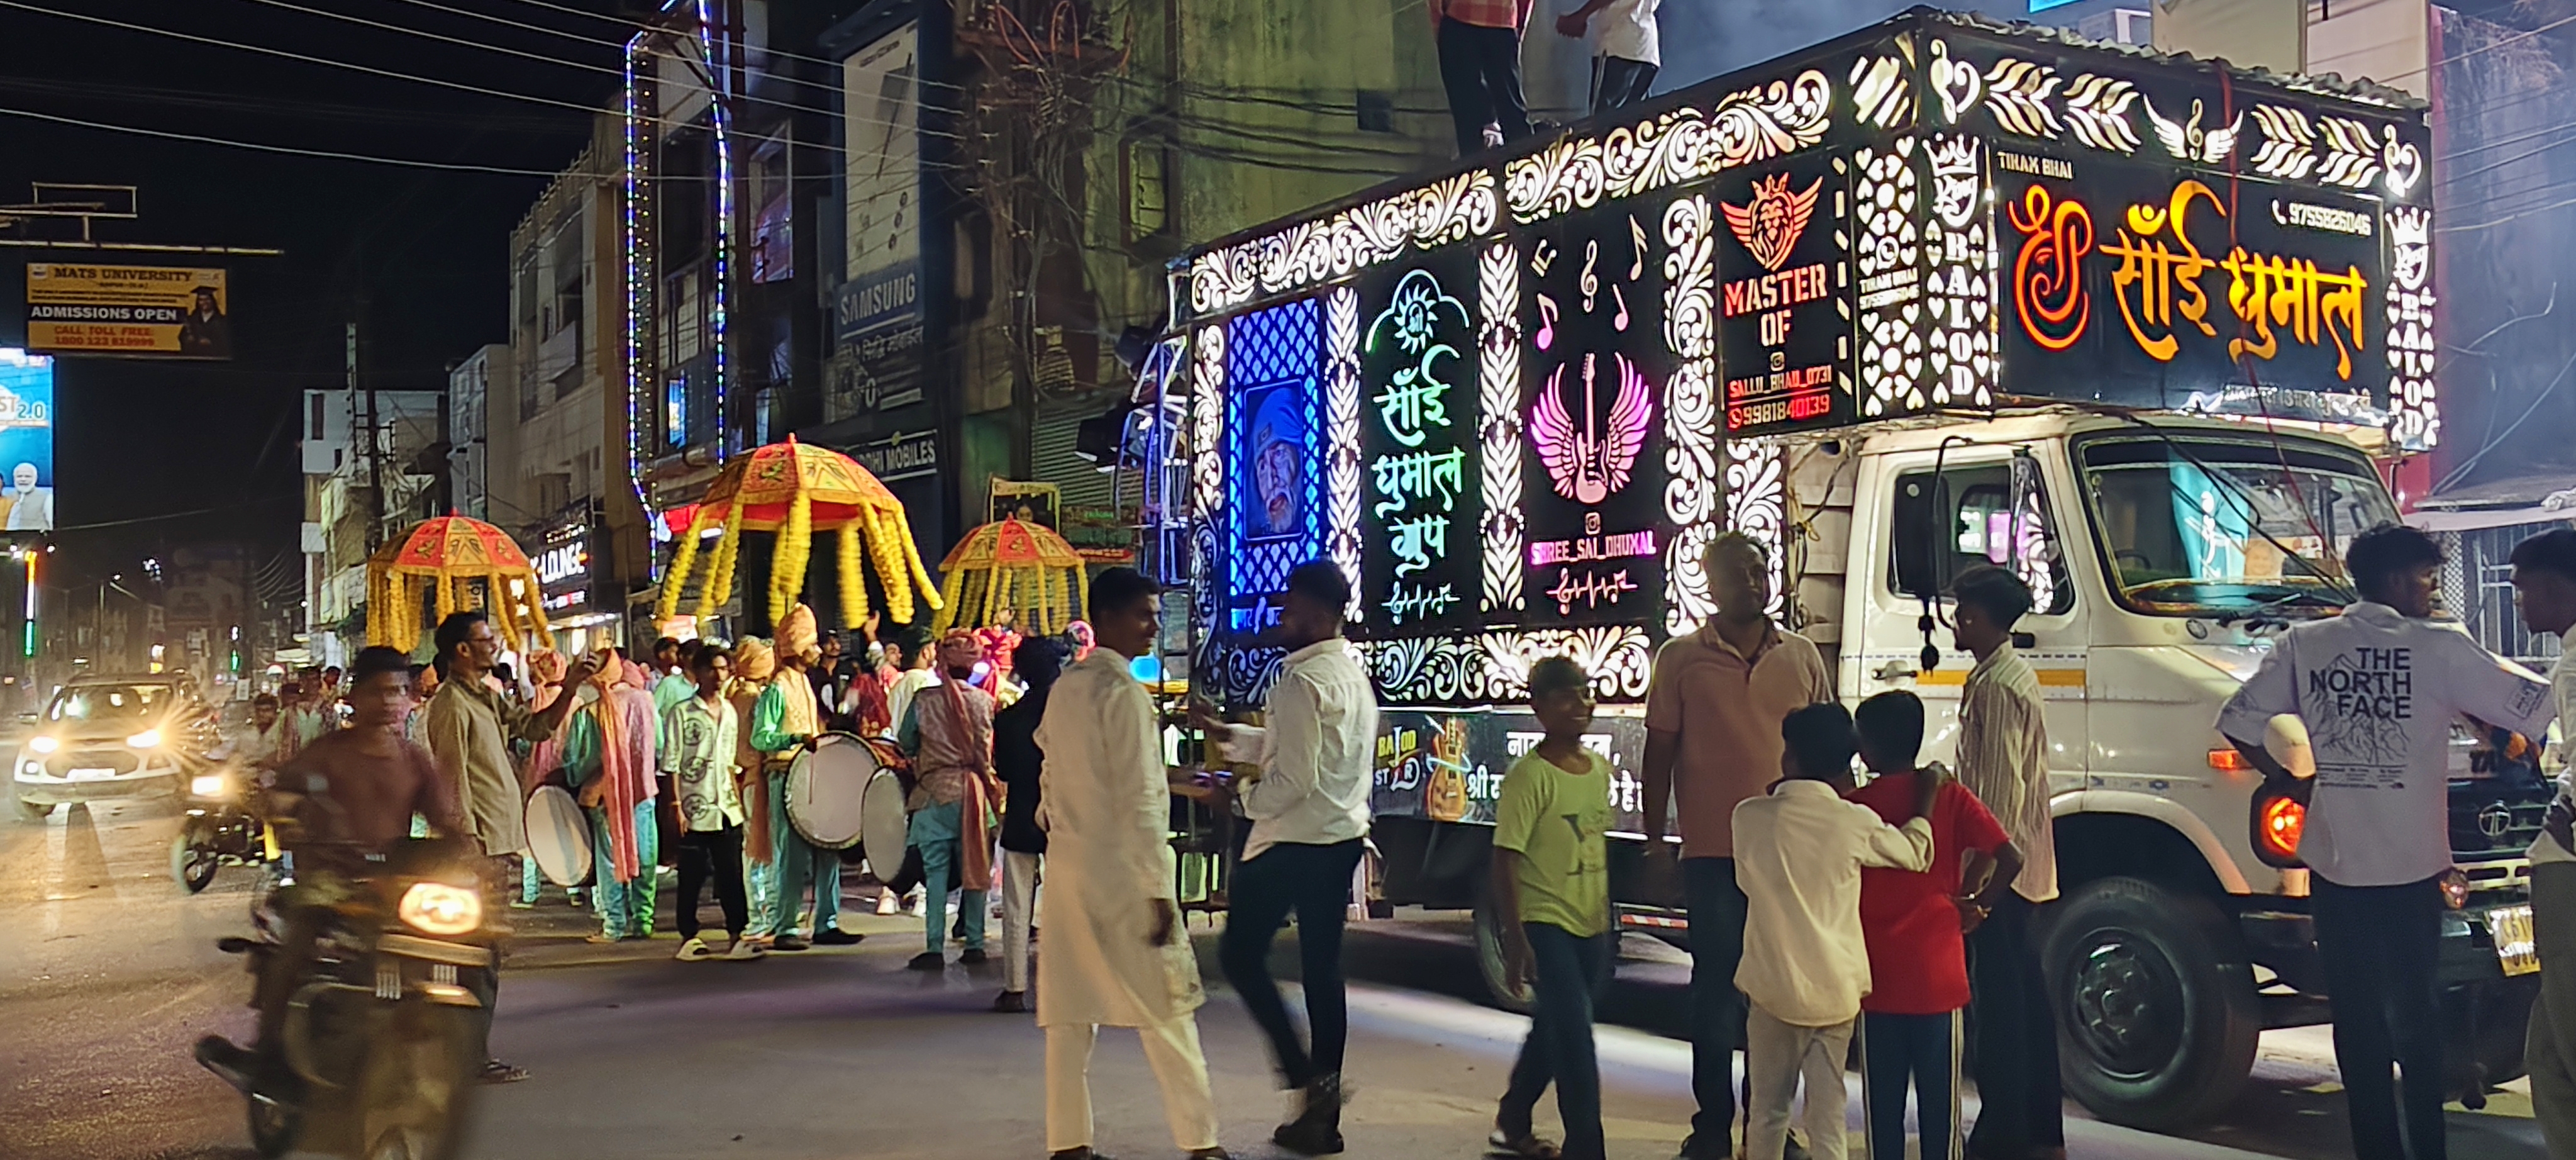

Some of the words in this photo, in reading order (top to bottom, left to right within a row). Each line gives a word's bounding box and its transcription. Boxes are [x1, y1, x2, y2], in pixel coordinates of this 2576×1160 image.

[2041, 157, 2074, 179] BHAI
[54, 267, 97, 279] MATS
[101, 269, 192, 282] UNIVERSITY
[841, 273, 916, 326] SAMSUNG
[1724, 263, 1828, 317] MASTER
[31, 305, 131, 320] ADMISSIONS
[134, 308, 177, 321] OPEN
[1945, 231, 1975, 396] BALOD
[54, 325, 84, 335] CALL
[88, 326, 116, 336] TOLL
[1761, 309, 1792, 347] OF
[18, 403, 44, 419] 2.0
[1743, 394, 1831, 426] 9981840139
[886, 439, 936, 472] MOBILES
[2355, 647, 2411, 671] THE
[2309, 670, 2411, 695] NORTH
[2337, 694, 2411, 718] FACE
